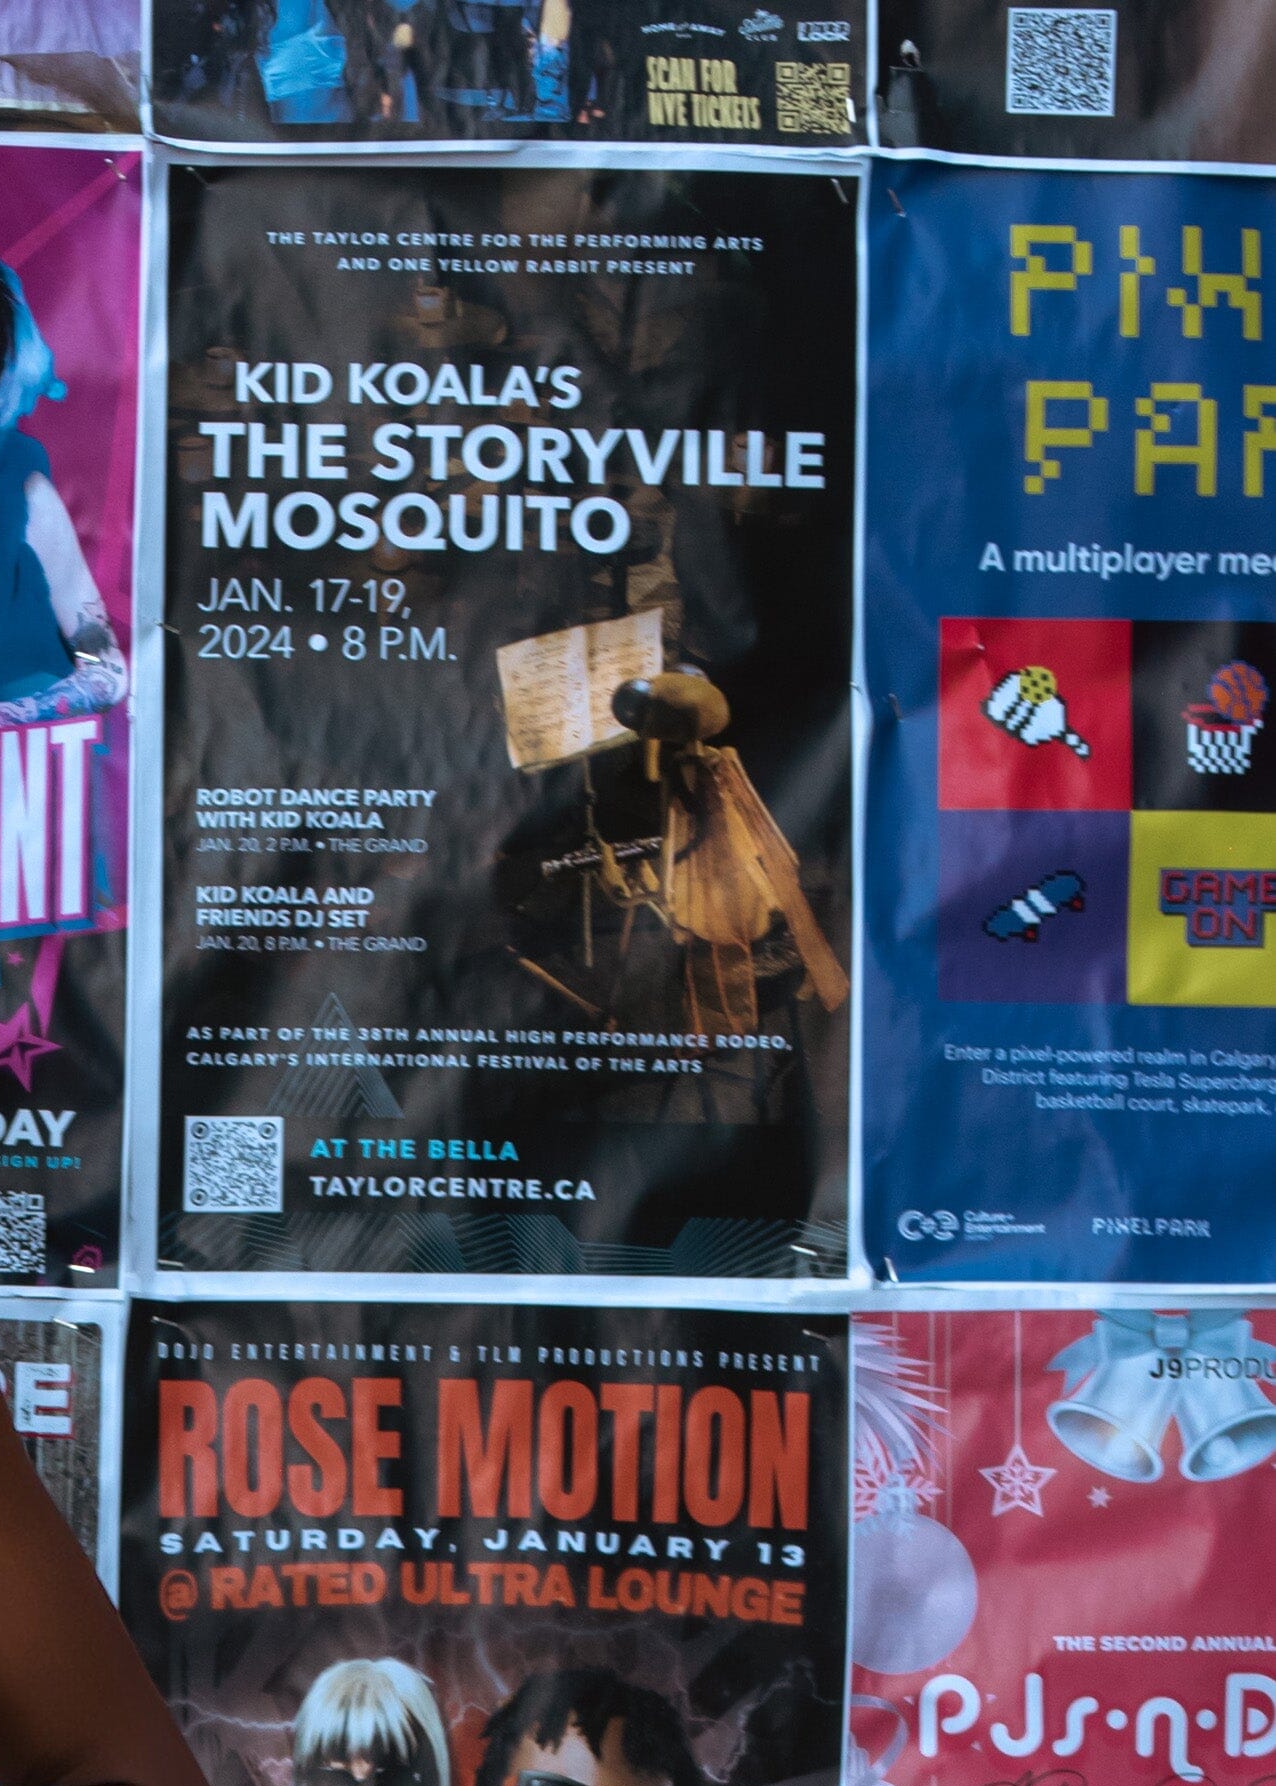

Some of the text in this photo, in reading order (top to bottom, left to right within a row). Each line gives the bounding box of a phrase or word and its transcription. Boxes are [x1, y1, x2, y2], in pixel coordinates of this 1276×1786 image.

[267, 231, 764, 251] THE TAYLOR CENTRE FOR THE PERFORMING ARTS
[236, 362, 333, 403] KID
[199, 421, 825, 490] THE STORYVILLE
[202, 491, 630, 554] MOSQUITO
[197, 579, 411, 620] JAN. 17-19,
[198, 625, 457, 661] 2024 P.M.
[310, 1138, 519, 1162] AT THE BELLA
[309, 1175, 596, 1202] TAYLORCENTRE.CA
[158, 1377, 809, 1531] ROSE MOTION
[161, 1529, 805, 1566] SATURDAY, JANUARY 13
[210, 1563, 804, 1626] RATED ULTRA LOUNGE
